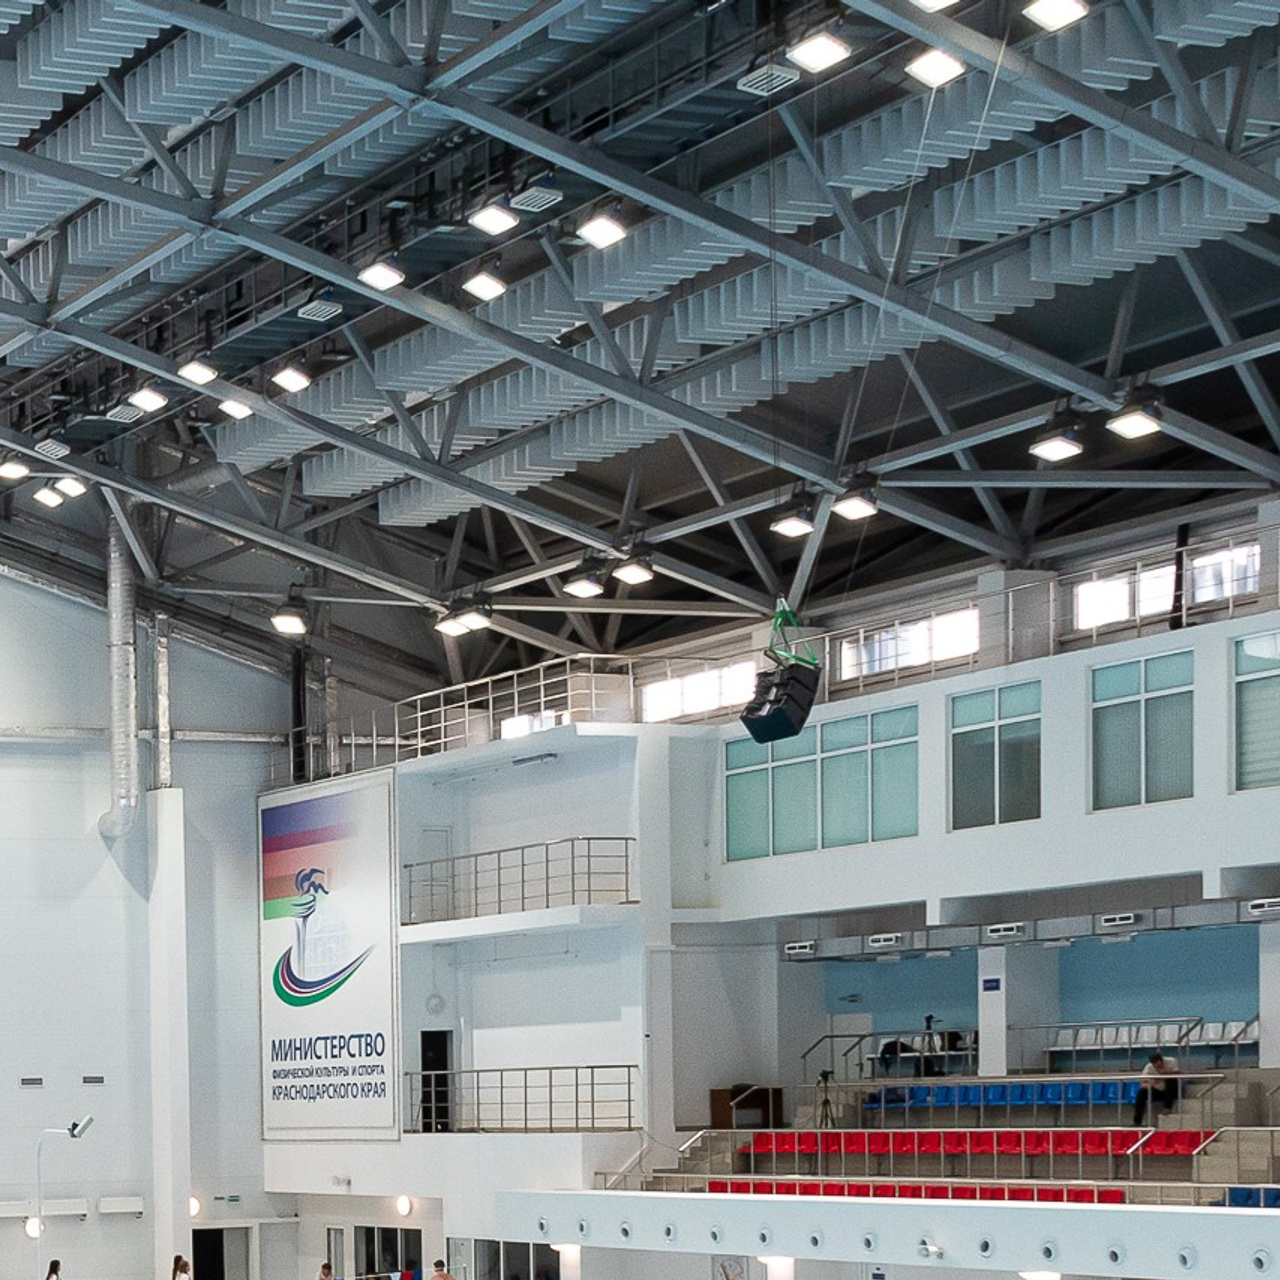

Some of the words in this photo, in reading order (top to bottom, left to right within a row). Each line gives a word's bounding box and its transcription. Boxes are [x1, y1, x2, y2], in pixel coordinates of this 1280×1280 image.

[271, 1032, 385, 1062] МИНИСТЕРСТВО
[272, 1065, 314, 1079] ФИЗИЧЕСКОЙ
[315, 1066, 349, 1078] КУЛЬТУРЫ
[351, 1065, 357, 1076] И
[358, 1064, 385, 1076] СПОРТА
[272, 1083, 359, 1102] КРАСНОДАРСКОГО
[360, 1082, 386, 1098] КРАЯ
